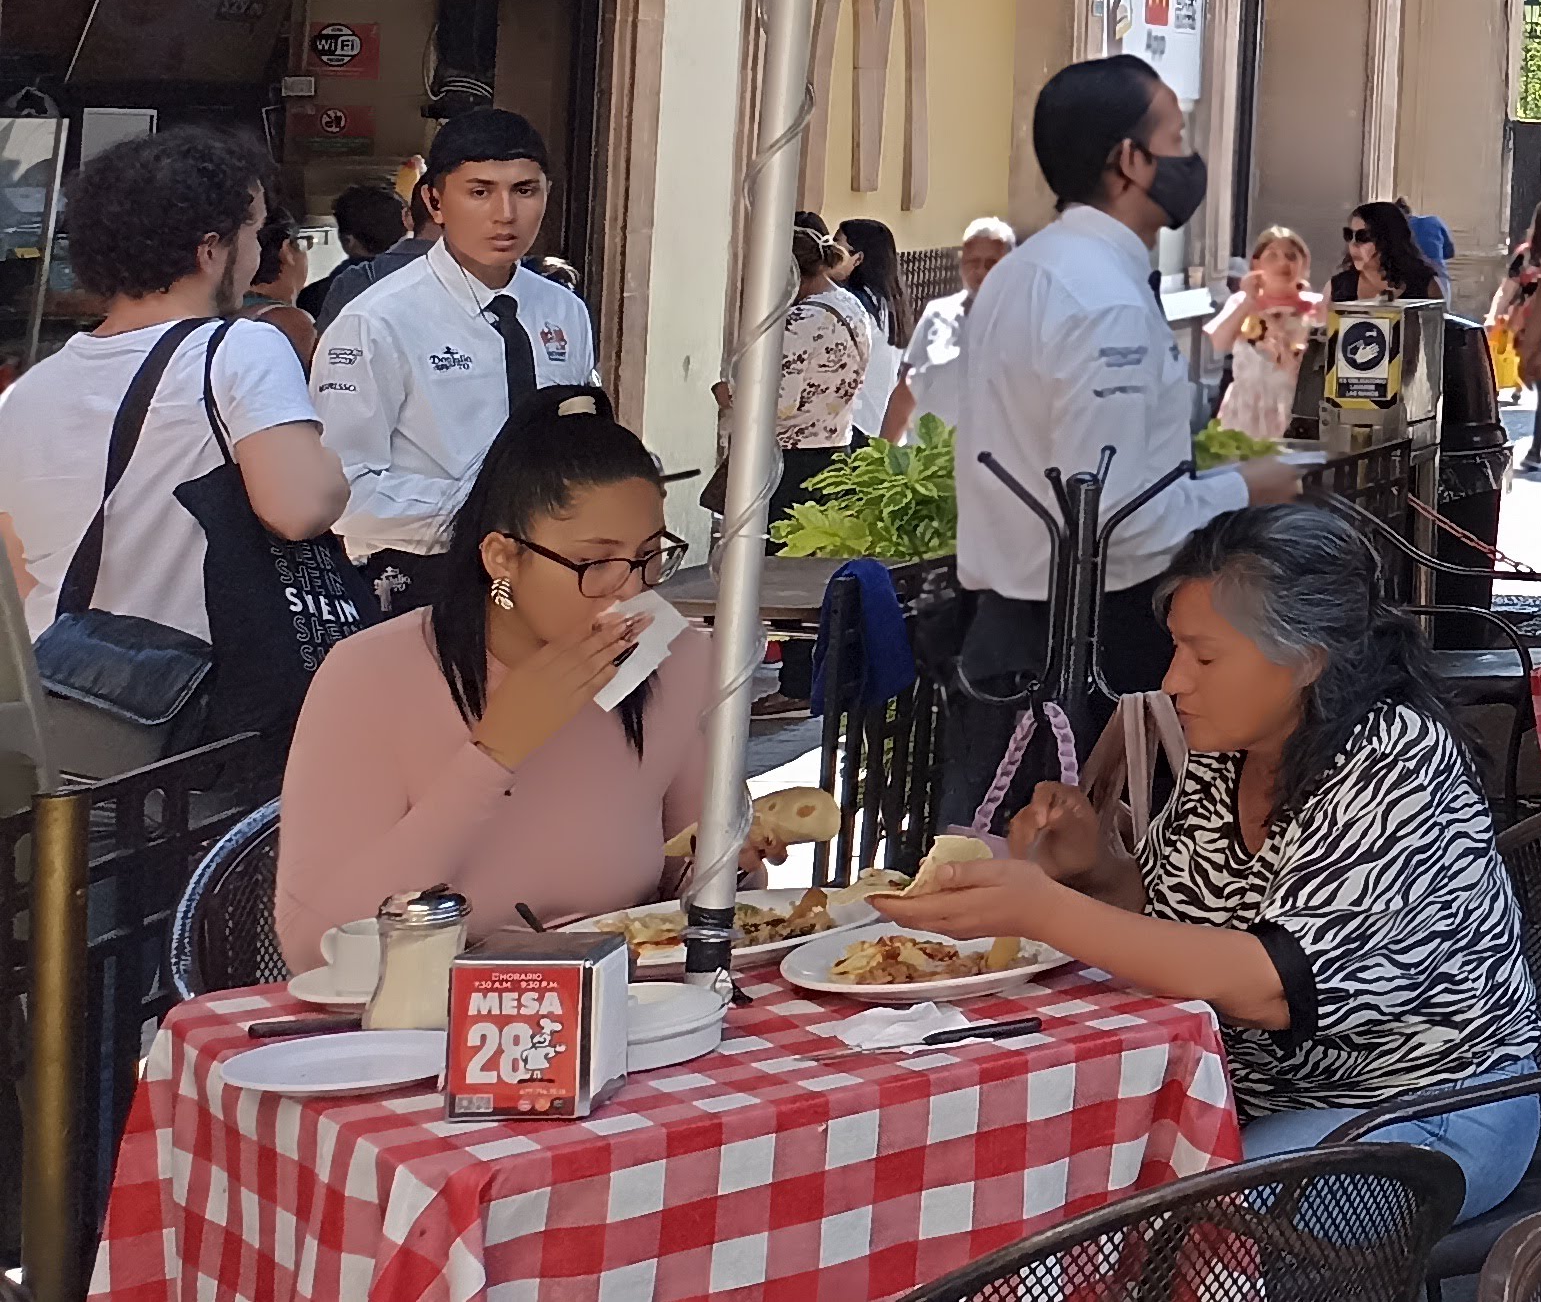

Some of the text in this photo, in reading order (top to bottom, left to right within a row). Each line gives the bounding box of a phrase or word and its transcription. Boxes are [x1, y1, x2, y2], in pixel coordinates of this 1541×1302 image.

[284, 586, 361, 623] STEIN
[499, 973, 543, 981] HORARIO
[468, 991, 563, 1016] MESA
[465, 1022, 533, 1084] 28
